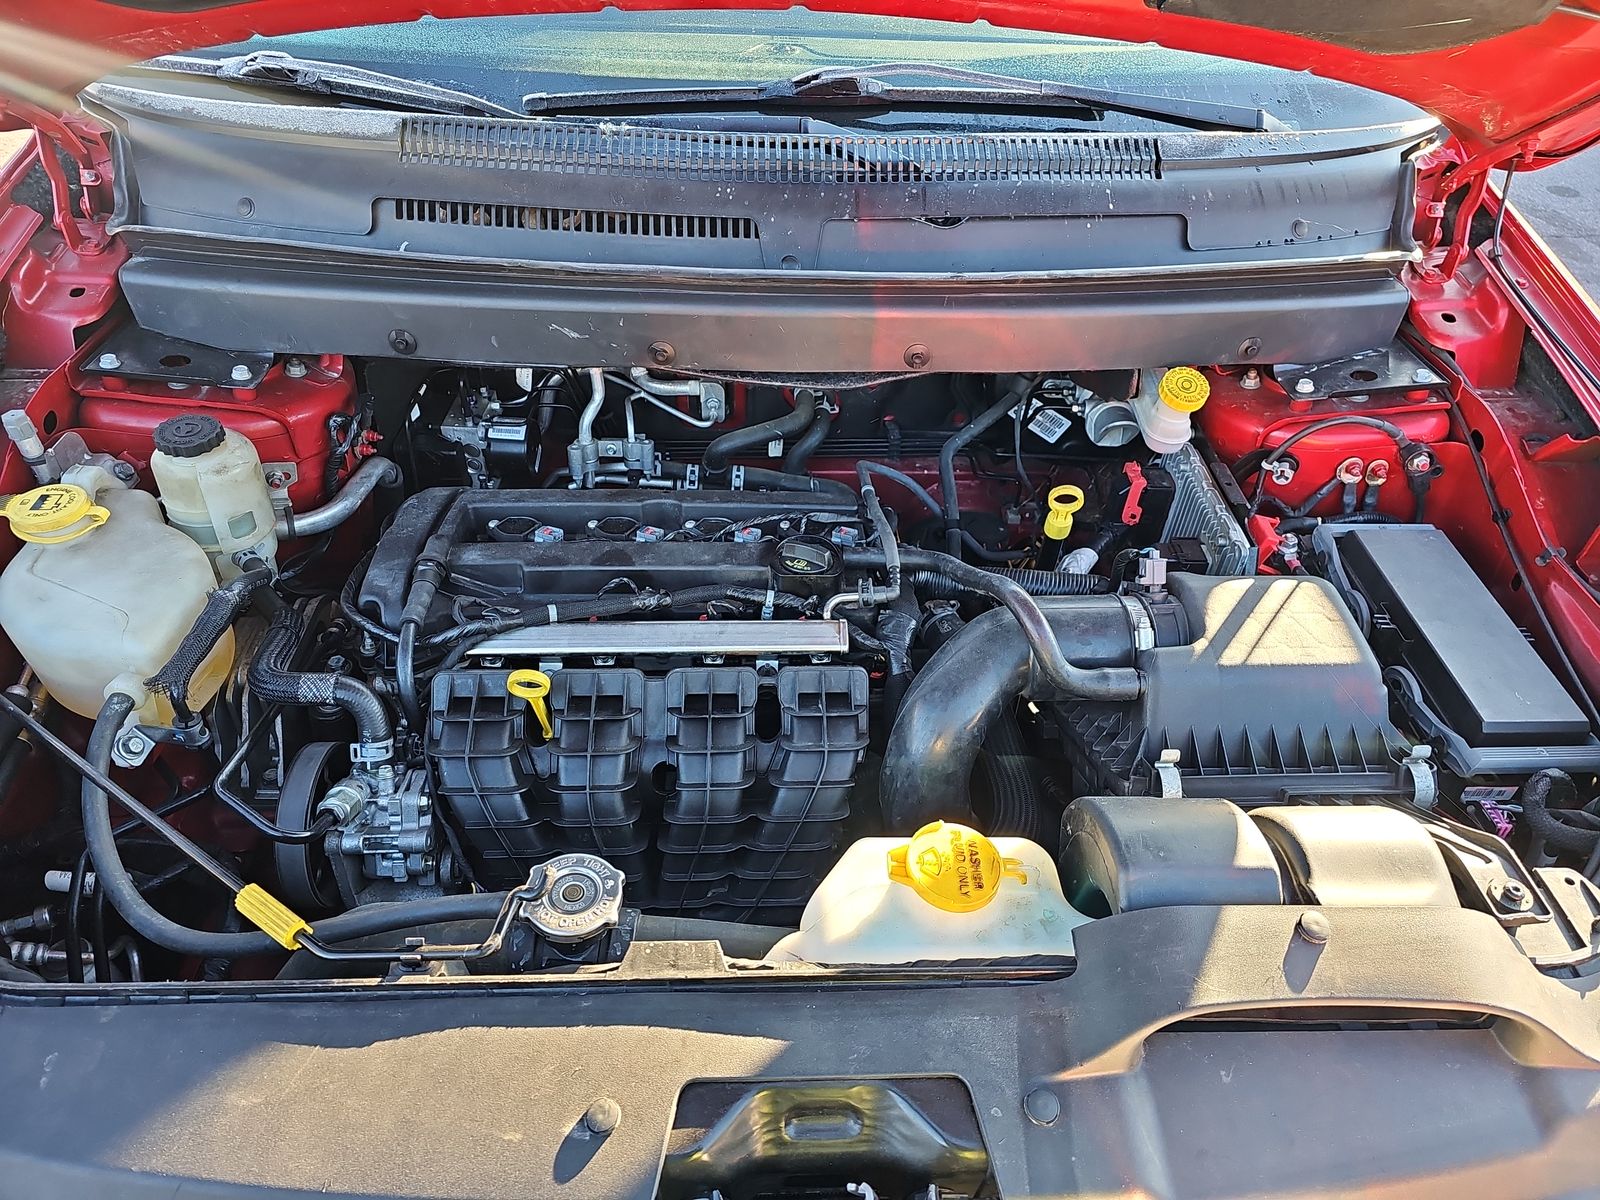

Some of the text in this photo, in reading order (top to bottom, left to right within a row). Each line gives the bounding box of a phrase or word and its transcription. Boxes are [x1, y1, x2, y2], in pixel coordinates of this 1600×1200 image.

[45, 487, 73, 495] ENGINE
[583, 858, 612, 878] TIGHT
[967, 839, 984, 890] WASHER
[956, 866, 971, 898] ONLY
[534, 904, 558, 924] NOT
[563, 902, 586, 911] MEXICO
[592, 893, 614, 918] HOT
[558, 912, 594, 928] OPEN
